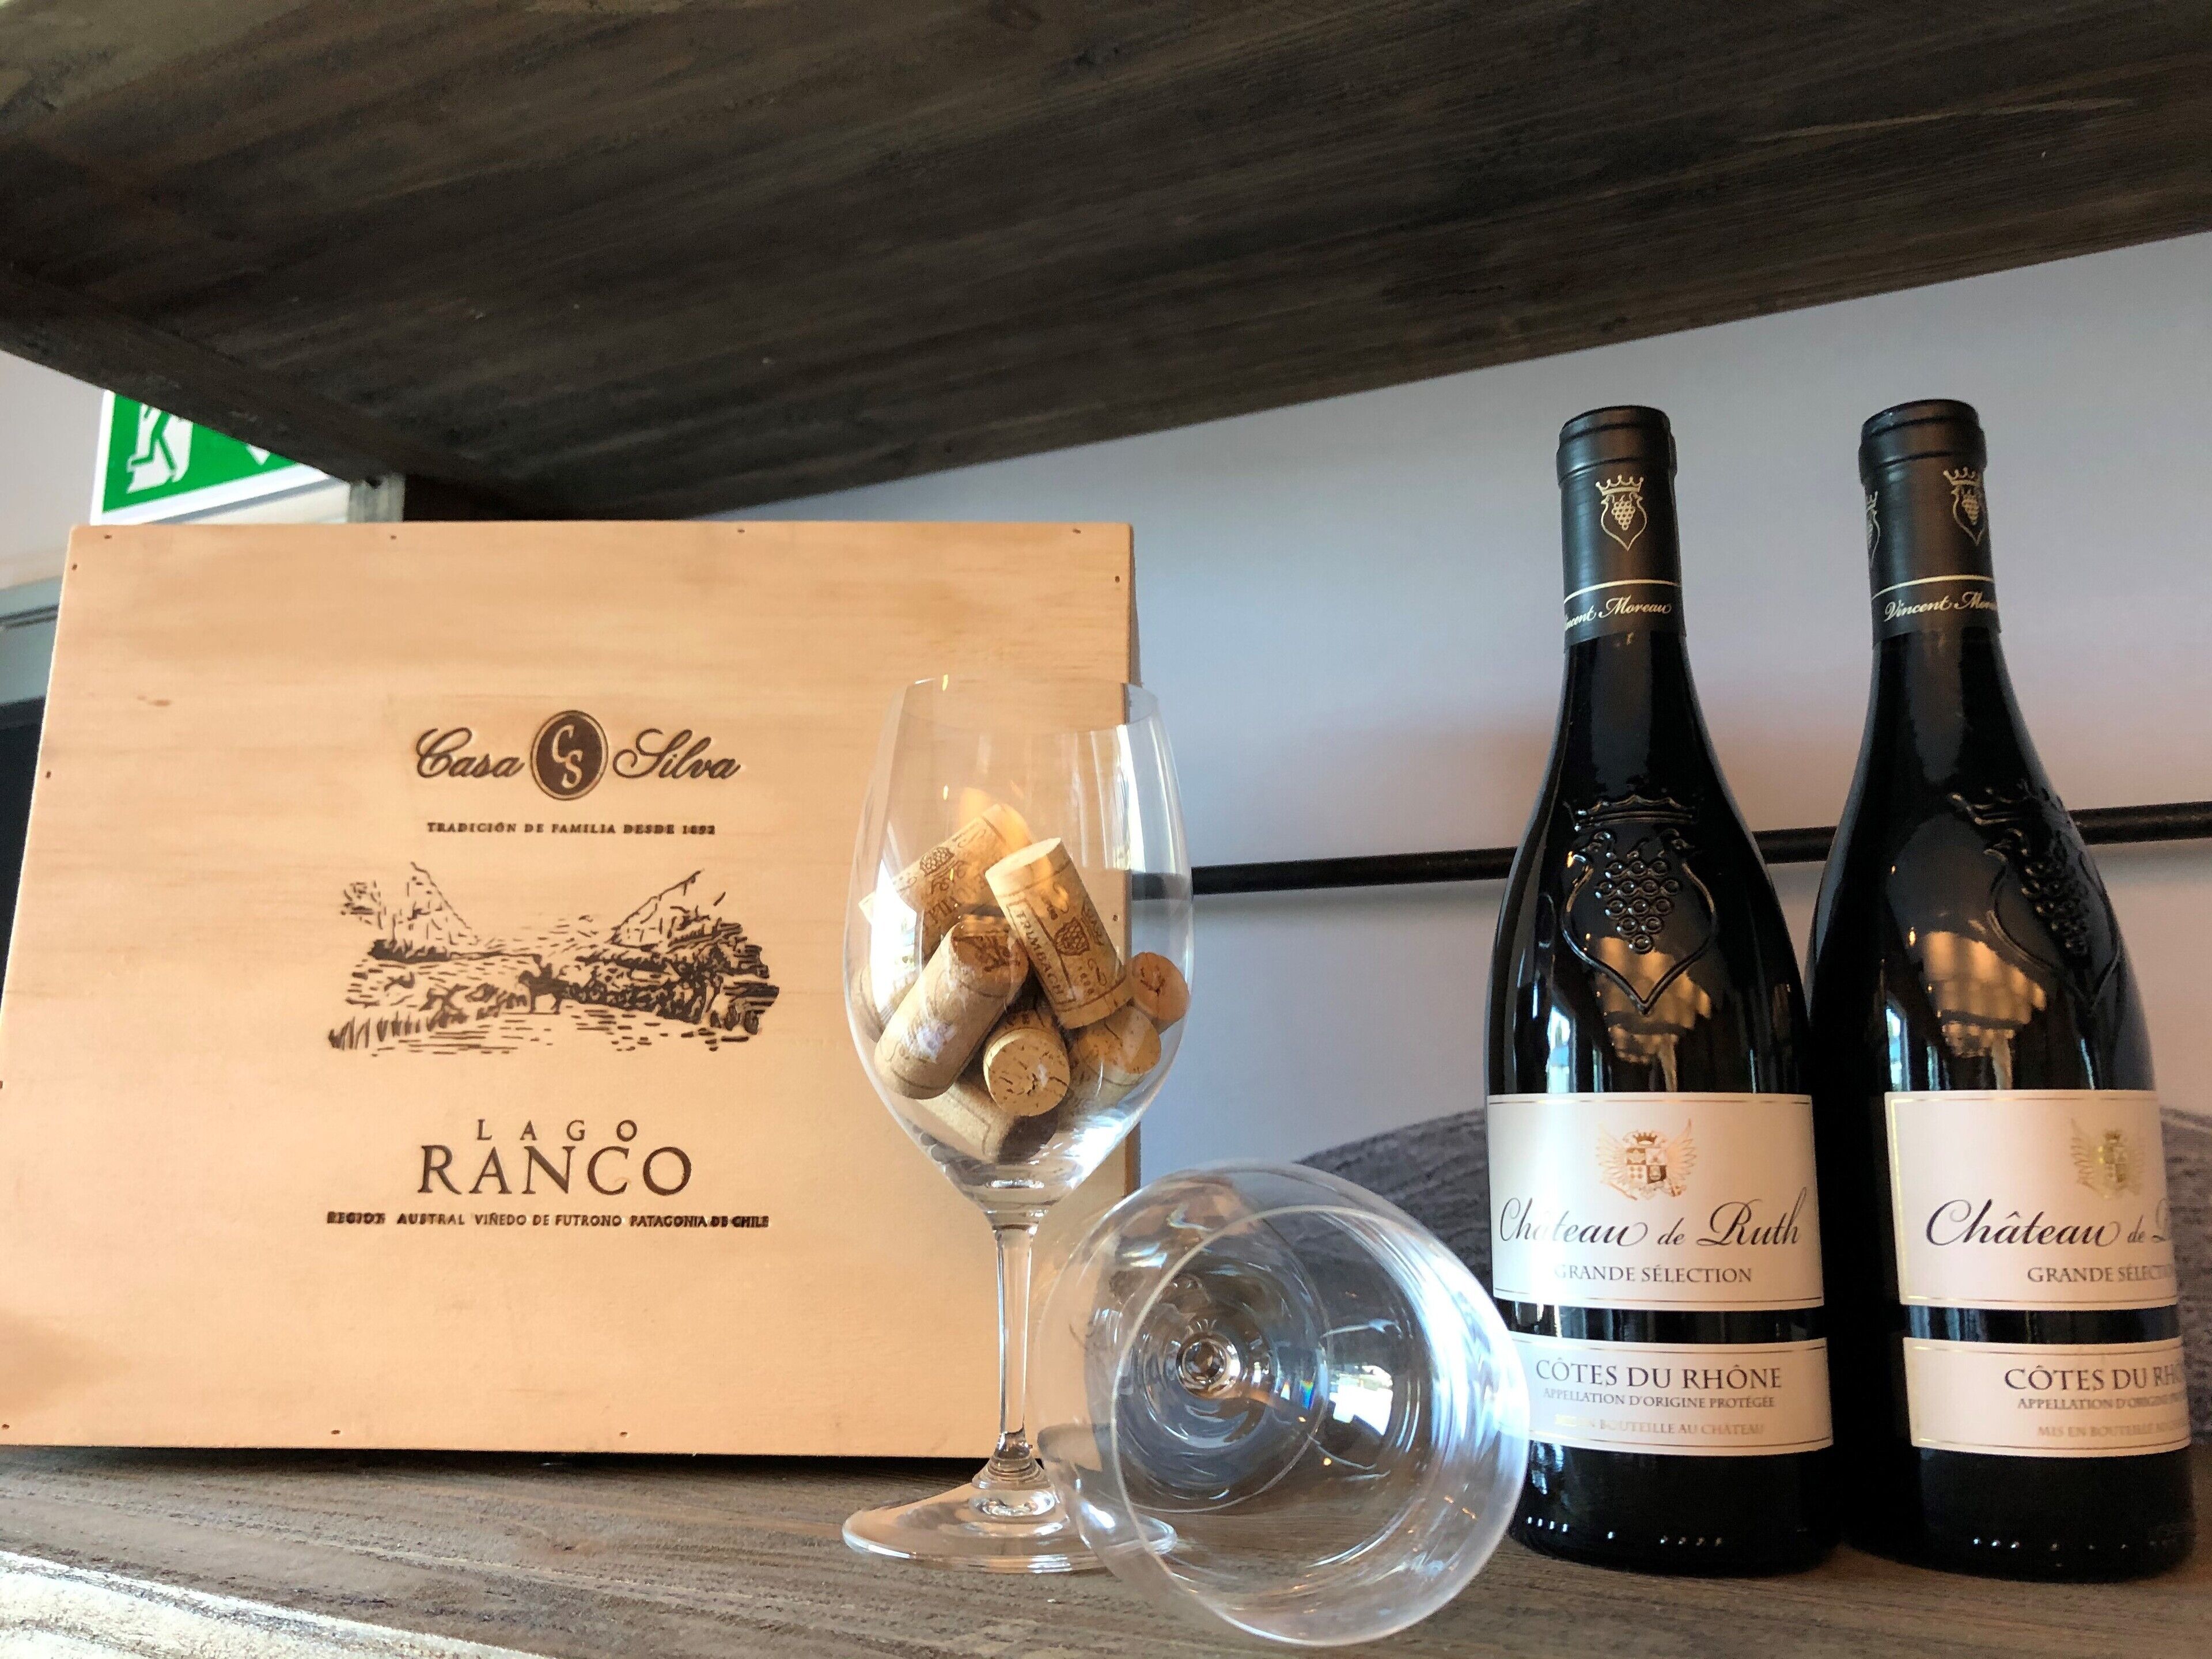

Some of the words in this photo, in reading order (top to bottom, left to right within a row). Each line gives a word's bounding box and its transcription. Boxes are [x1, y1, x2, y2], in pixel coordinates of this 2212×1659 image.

[1599, 594, 1672, 619] Moreau
[1884, 595, 1953, 622] Vincent
[416, 728, 525, 778] Casa
[613, 729, 741, 779] Silva
[427, 822, 516, 833] TRADICIÓN
[524, 824, 544, 833] DE
[551, 824, 616, 834] FAMILIA
[623, 824, 675, 834] DESDE
[476, 1119, 638, 1142] LAGO
[417, 1144, 692, 1196] RANCO
[396, 1213, 465, 1225] AUSTRAL
[475, 1212, 527, 1226] VIÑEDO
[532, 1214, 550, 1226] DE
[555, 1215, 622, 1226] FUTRONO
[630, 1215, 707, 1228] PATAGONIA
[710, 1216, 729, 1228] DE
[732, 1216, 770, 1228] CHILE
[1657, 1217, 1686, 1245] de
[1696, 1186, 1807, 1246] Ruth
[1926, 1198, 2122, 1247] Château
[2127, 1214, 2145, 1244] de
[1555, 1264, 1635, 1282] GRANDE
[1641, 1264, 1752, 1283] SÉLECTION
[2027, 1267, 2113, 1283] GRANDE
[1536, 1357, 1618, 1387] CÔTES
[1627, 1367, 1671, 1389] DU
[1681, 1365, 1782, 1390] RHÔNE
[2004, 1365, 2105, 1391] CÔTES
[2111, 1368, 2147, 1390] DU
[1544, 1387, 1624, 1406] APPELLATION
[1630, 1395, 1706, 1408] D'ORIGINE
[1679, 1423, 1697, 1434] AU
